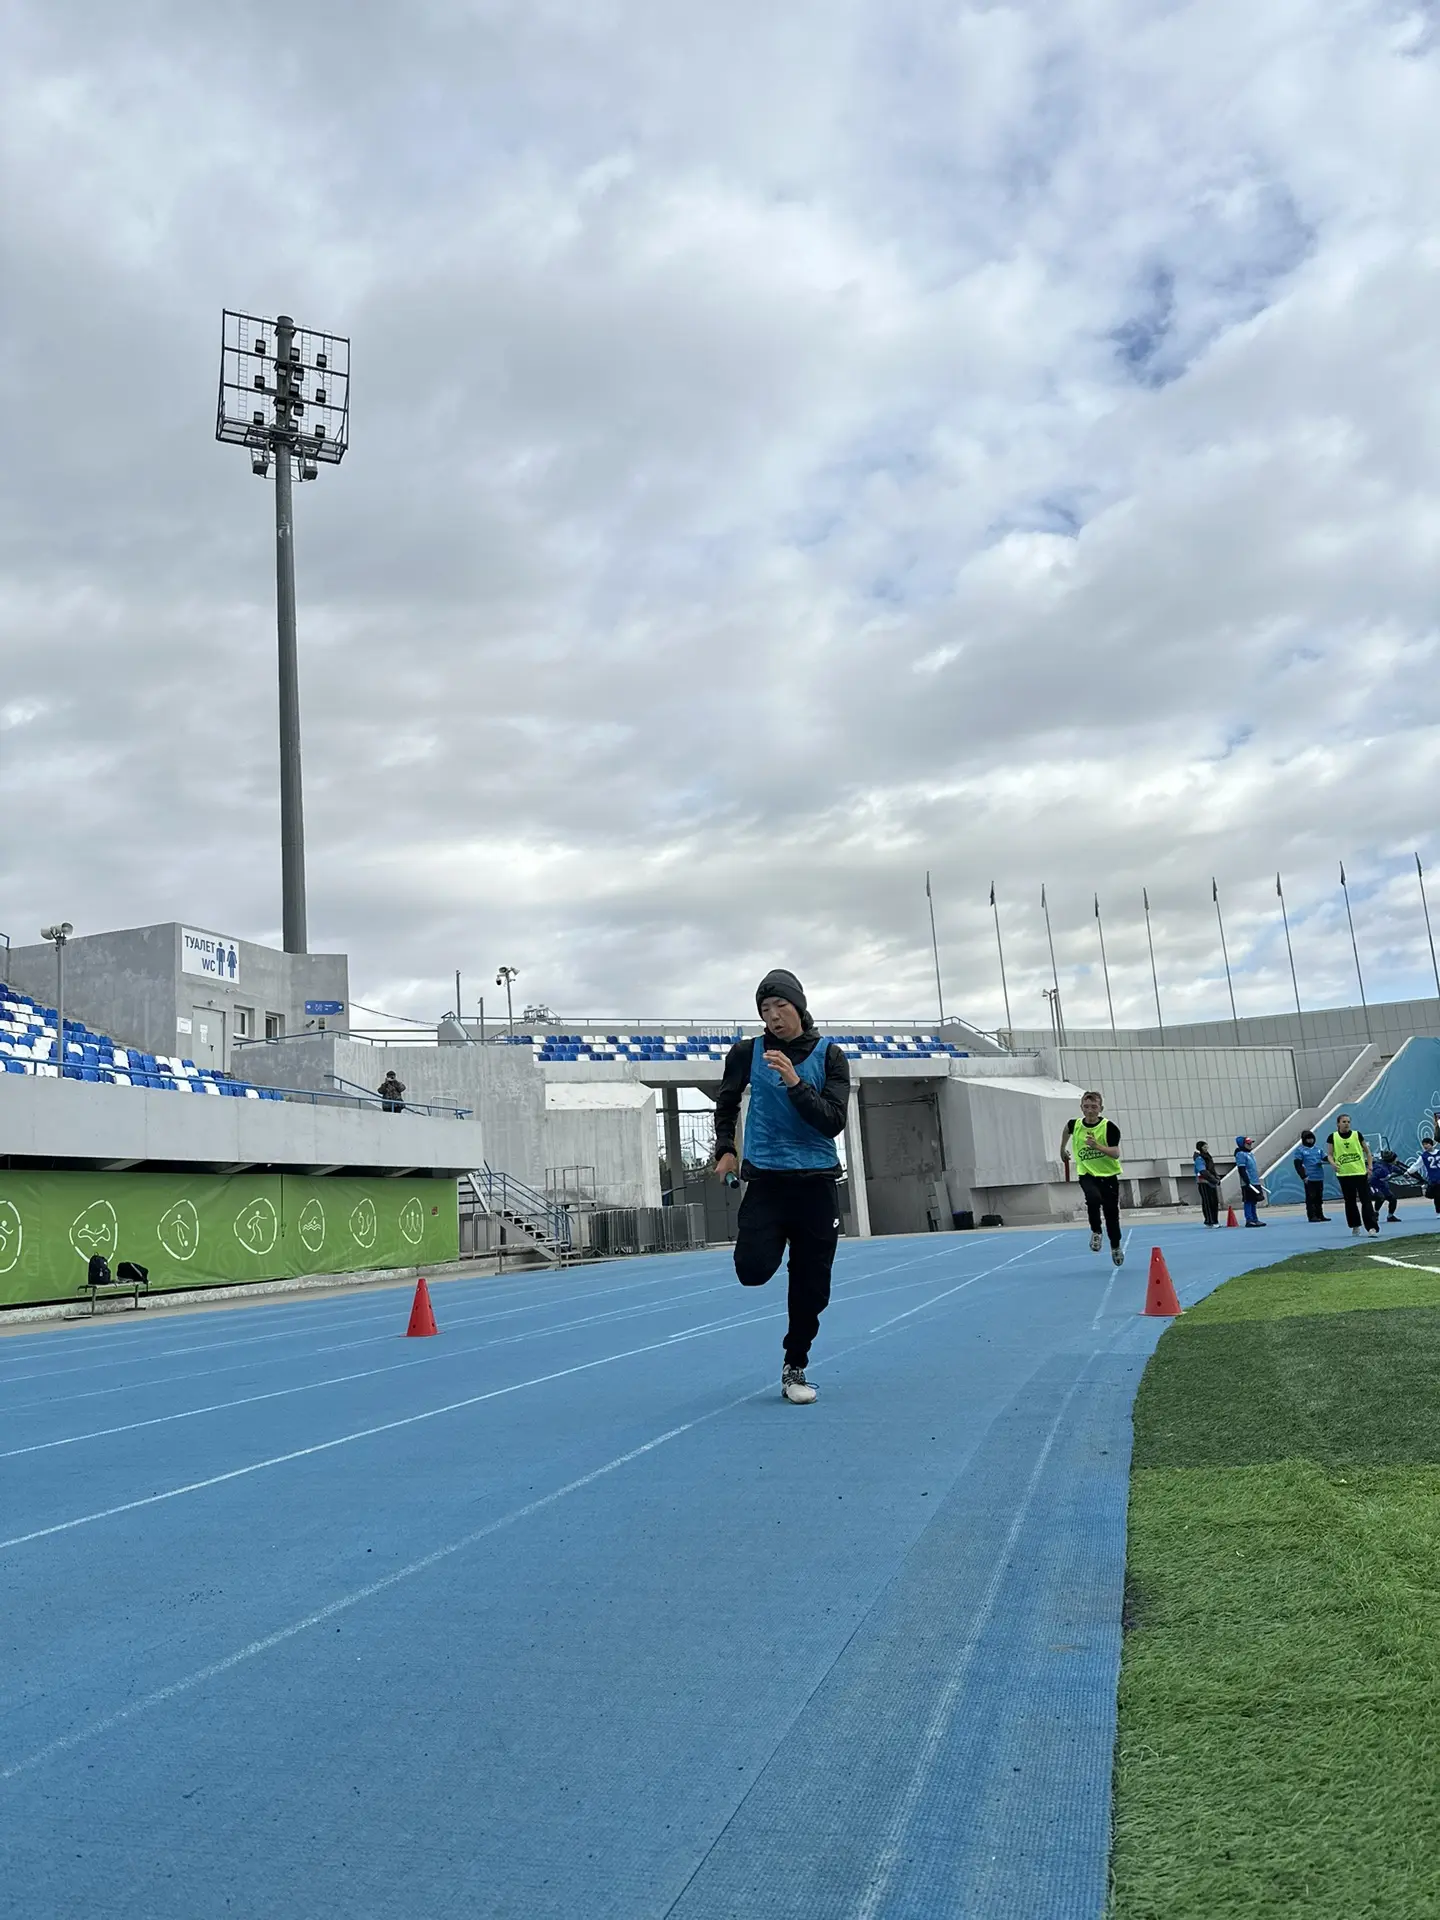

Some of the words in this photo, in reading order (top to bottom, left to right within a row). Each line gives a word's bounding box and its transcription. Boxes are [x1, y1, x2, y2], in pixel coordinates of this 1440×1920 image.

[184, 935, 216, 953] ТУАЛЕТ
[201, 957, 216, 972] WC
[700, 1027, 735, 1037] СЕКТОР
